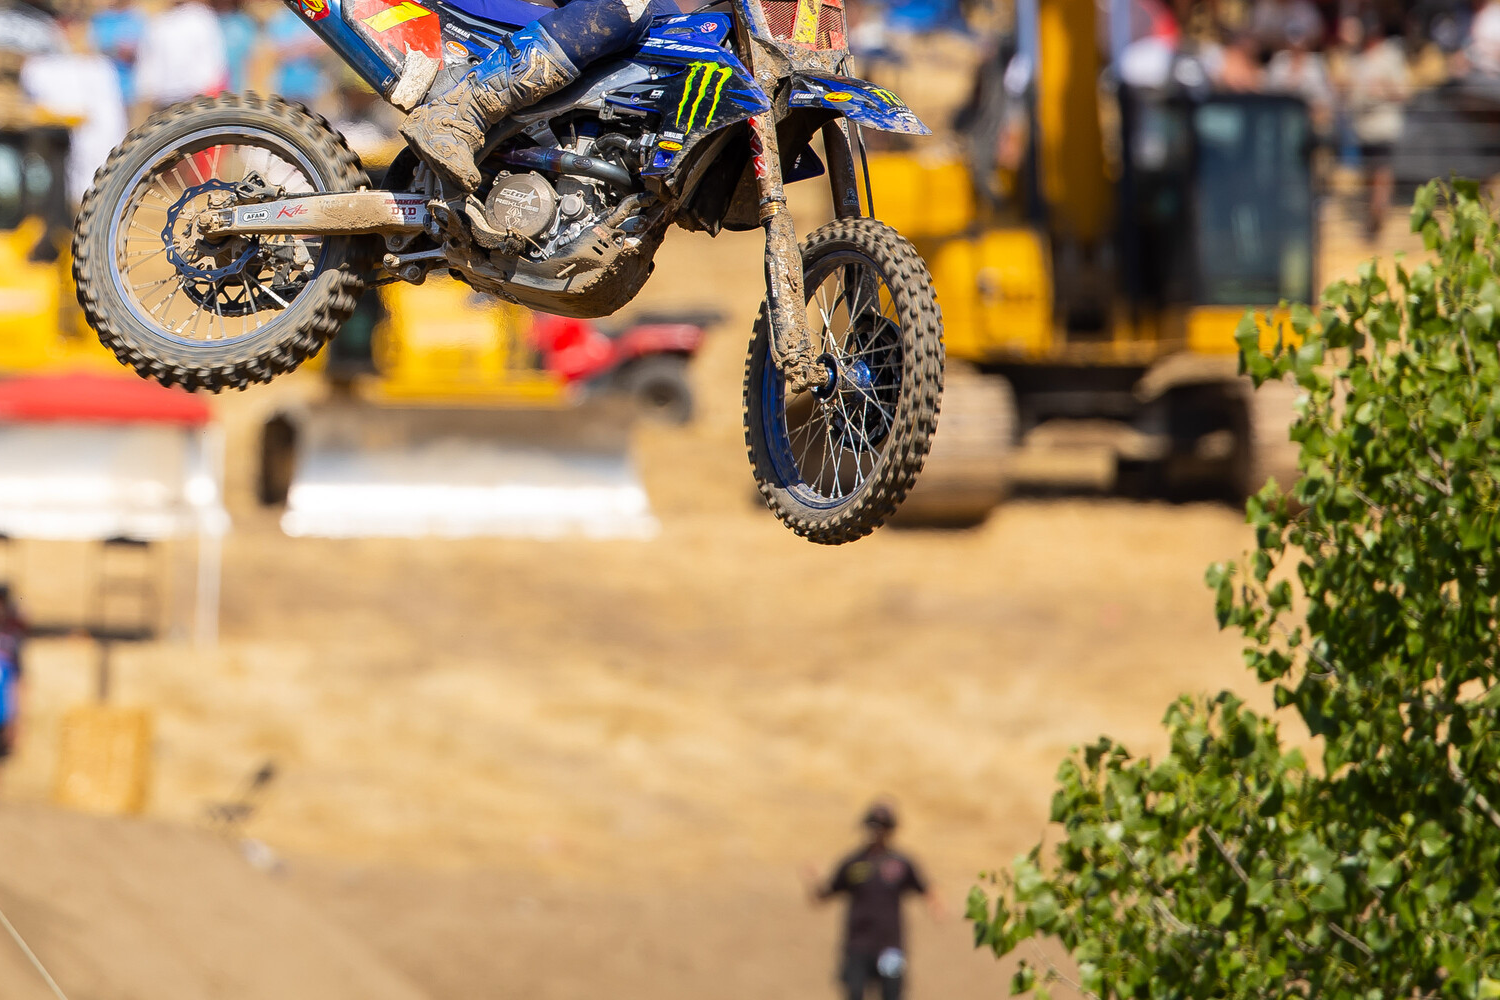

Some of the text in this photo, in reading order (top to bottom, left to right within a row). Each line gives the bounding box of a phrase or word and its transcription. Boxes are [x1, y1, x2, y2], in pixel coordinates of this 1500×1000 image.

[361, 1, 432, 33] 1
[495, 197, 540, 213] REKLUSE
[246, 211, 265, 220] AFAM
